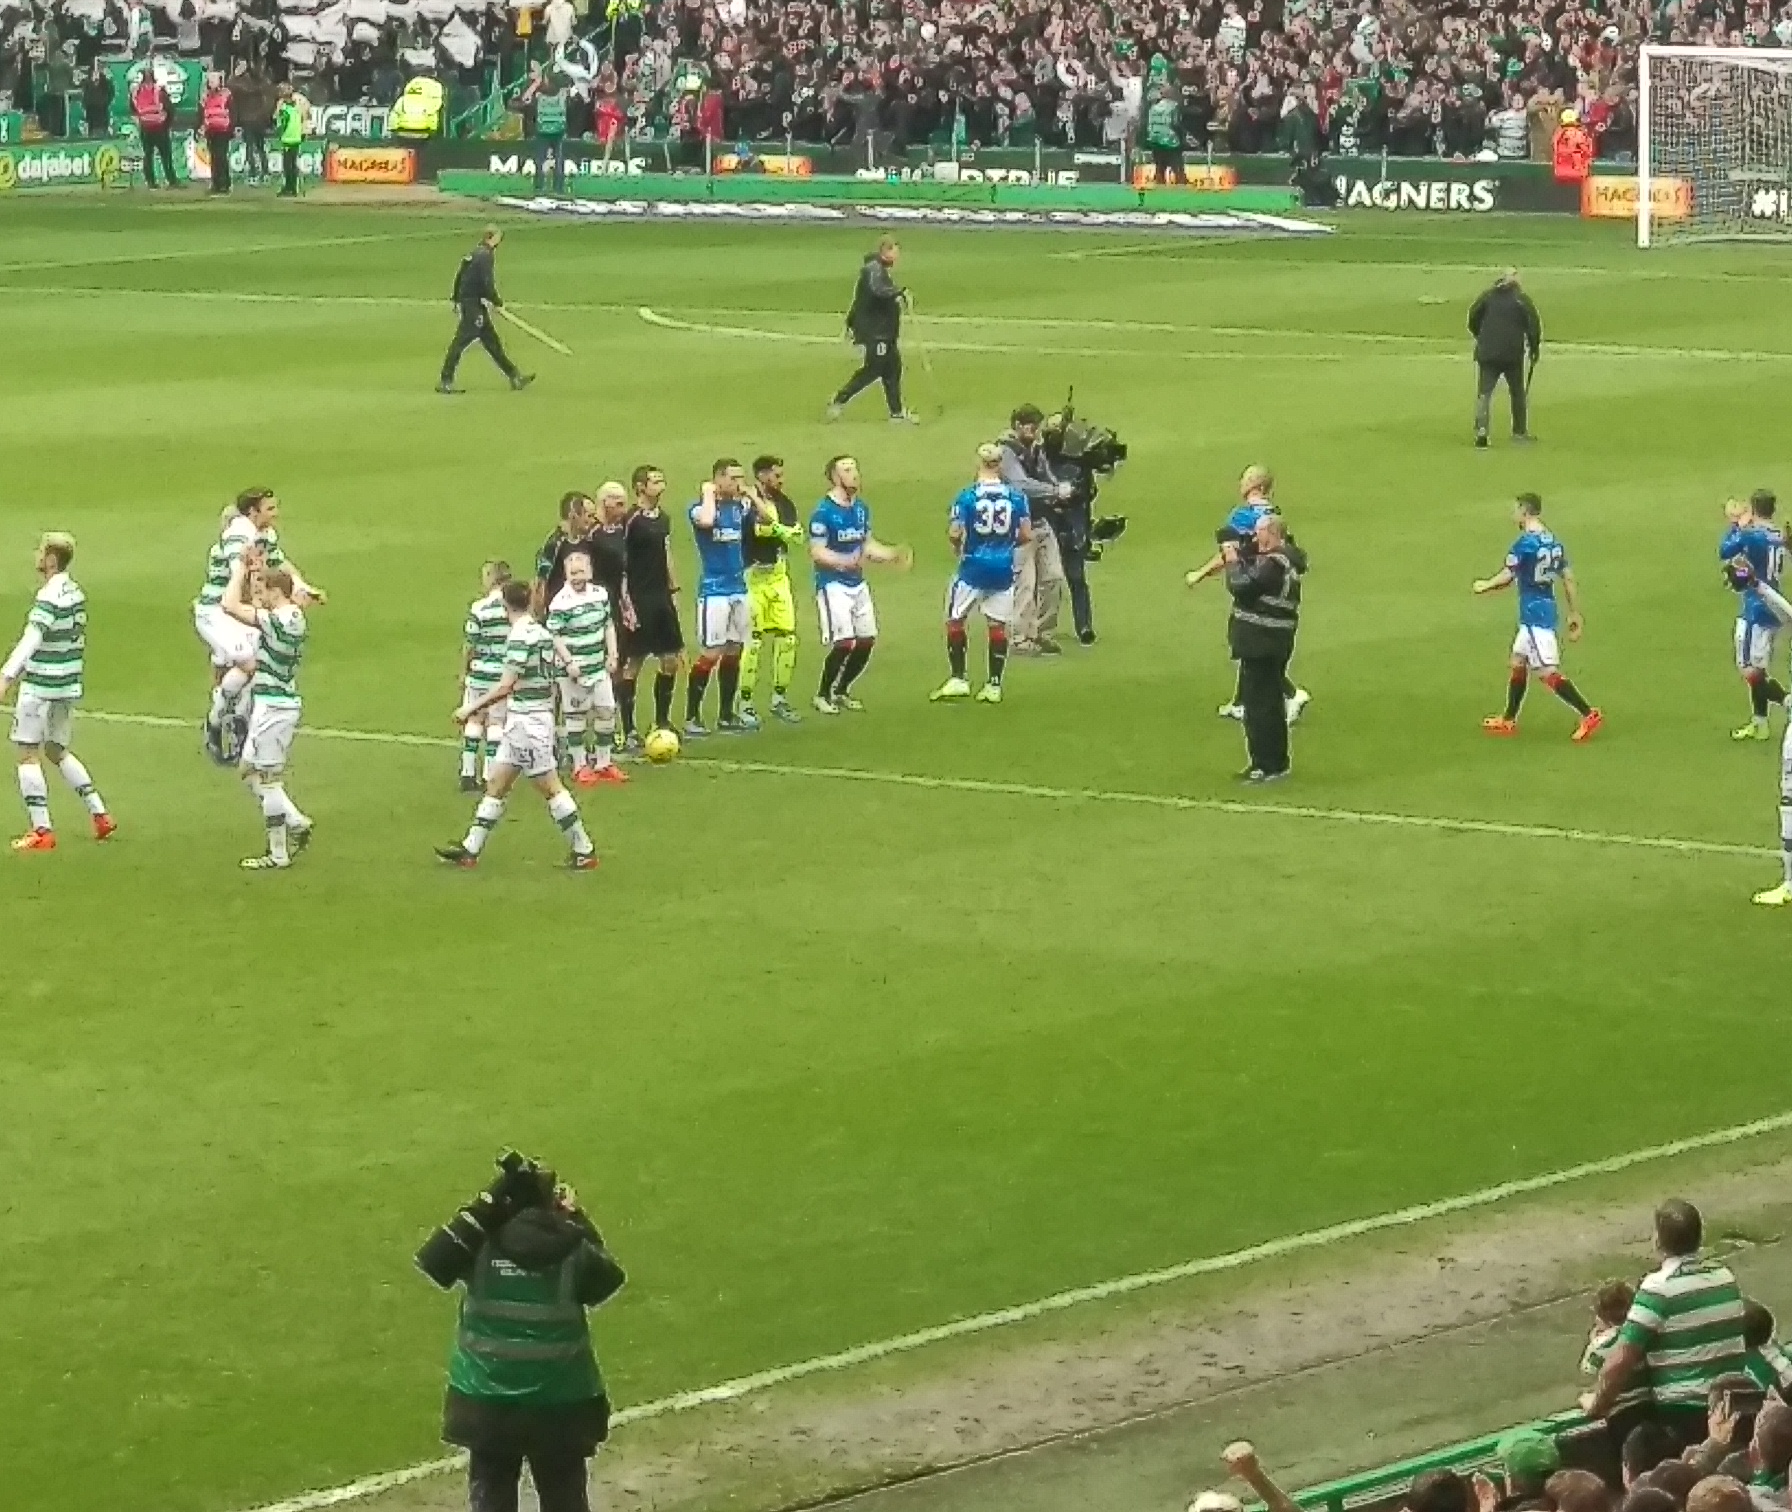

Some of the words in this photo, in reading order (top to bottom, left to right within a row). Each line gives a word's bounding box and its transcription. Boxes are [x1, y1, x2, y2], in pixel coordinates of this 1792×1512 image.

[17, 146, 92, 179] dafabet
[229, 141, 323, 175] daet
[974, 499, 1013, 535] 33
